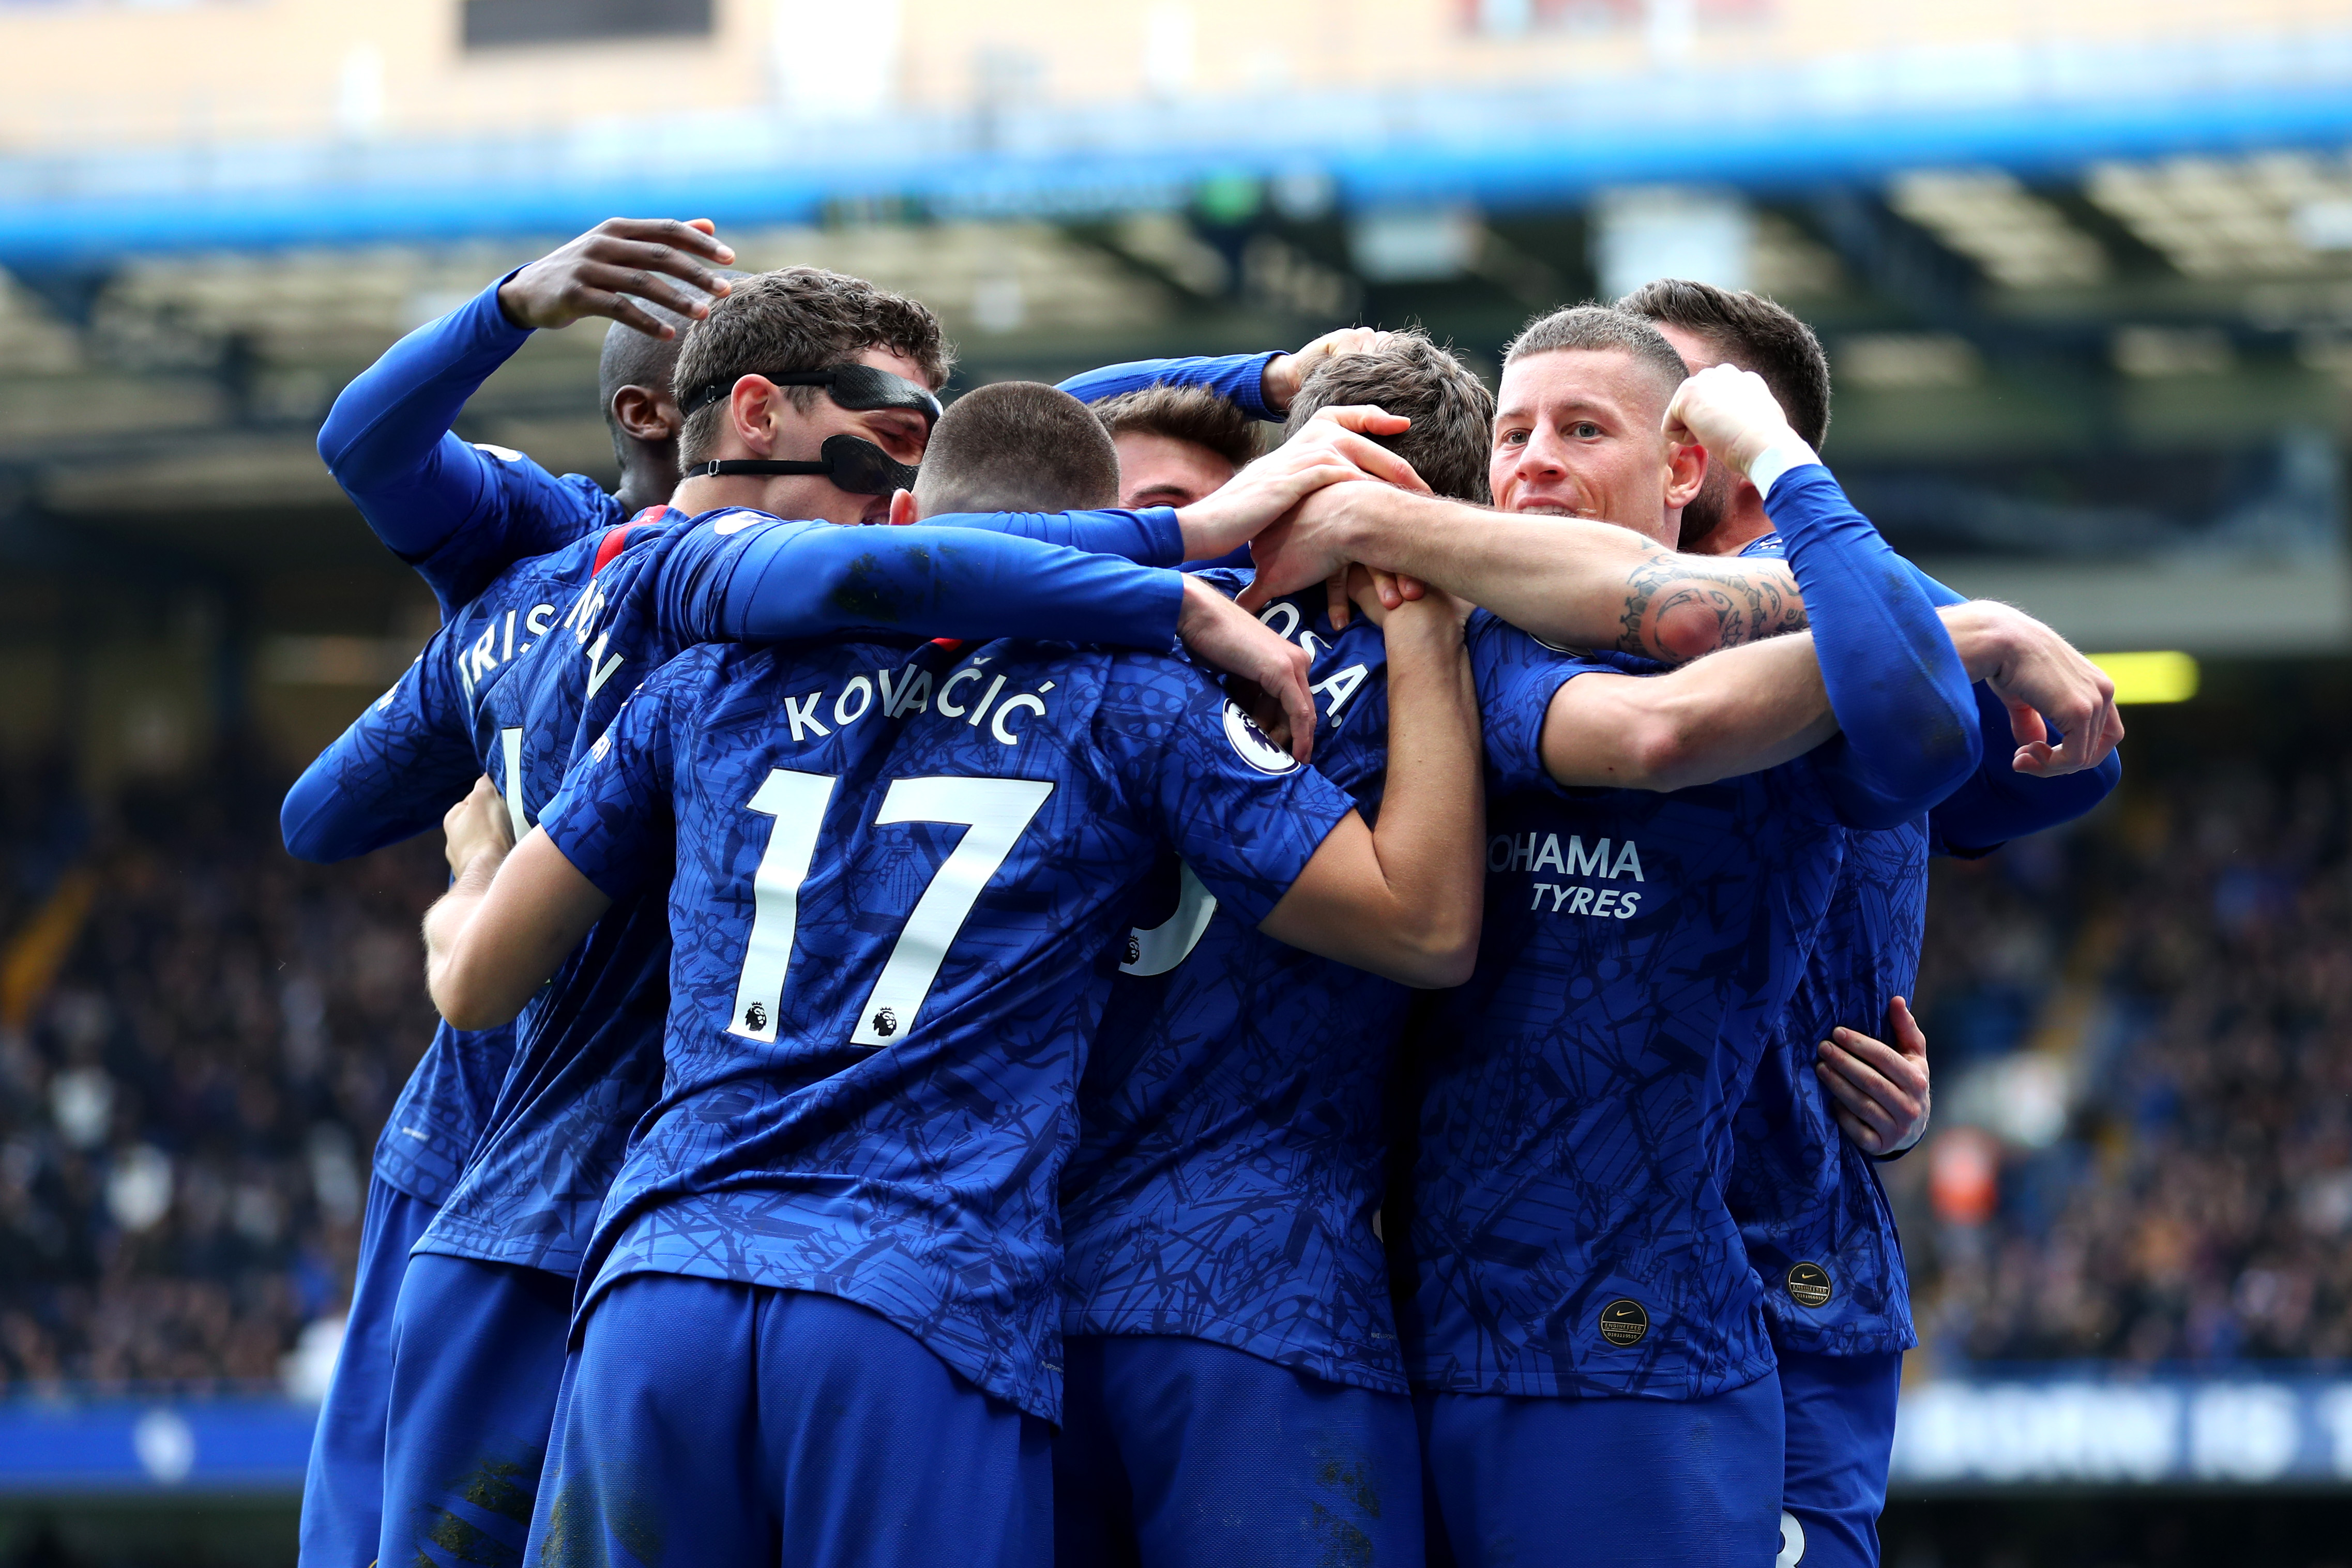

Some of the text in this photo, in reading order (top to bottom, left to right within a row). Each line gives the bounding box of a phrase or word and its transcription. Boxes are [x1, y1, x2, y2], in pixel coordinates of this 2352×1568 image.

[784, 657, 1056, 745] KOVAČIĆ
[1485, 832, 1645, 882] OHAMA
[725, 768, 1054, 1047] 17
[1530, 883, 1642, 919] TYRES
